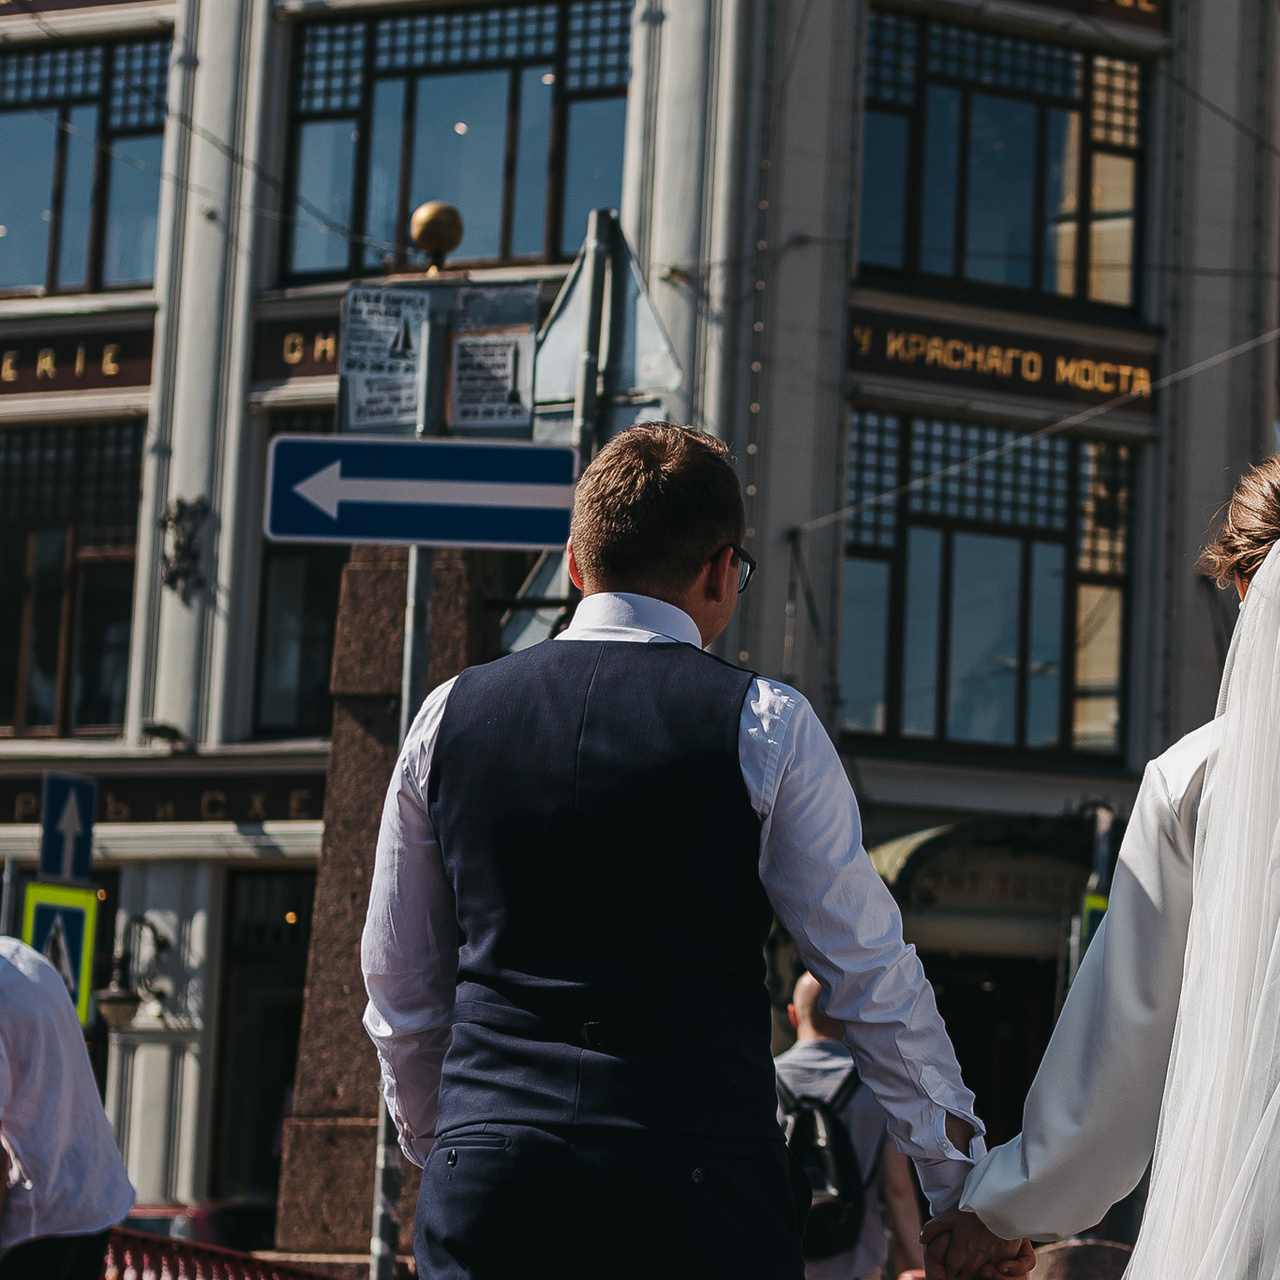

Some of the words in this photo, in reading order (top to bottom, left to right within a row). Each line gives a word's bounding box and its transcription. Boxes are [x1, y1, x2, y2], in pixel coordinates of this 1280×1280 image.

[854, 325, 873, 356] У
[886, 330, 1043, 382] КРАСНАГО
[1055, 356, 1152, 398] МОСТА
